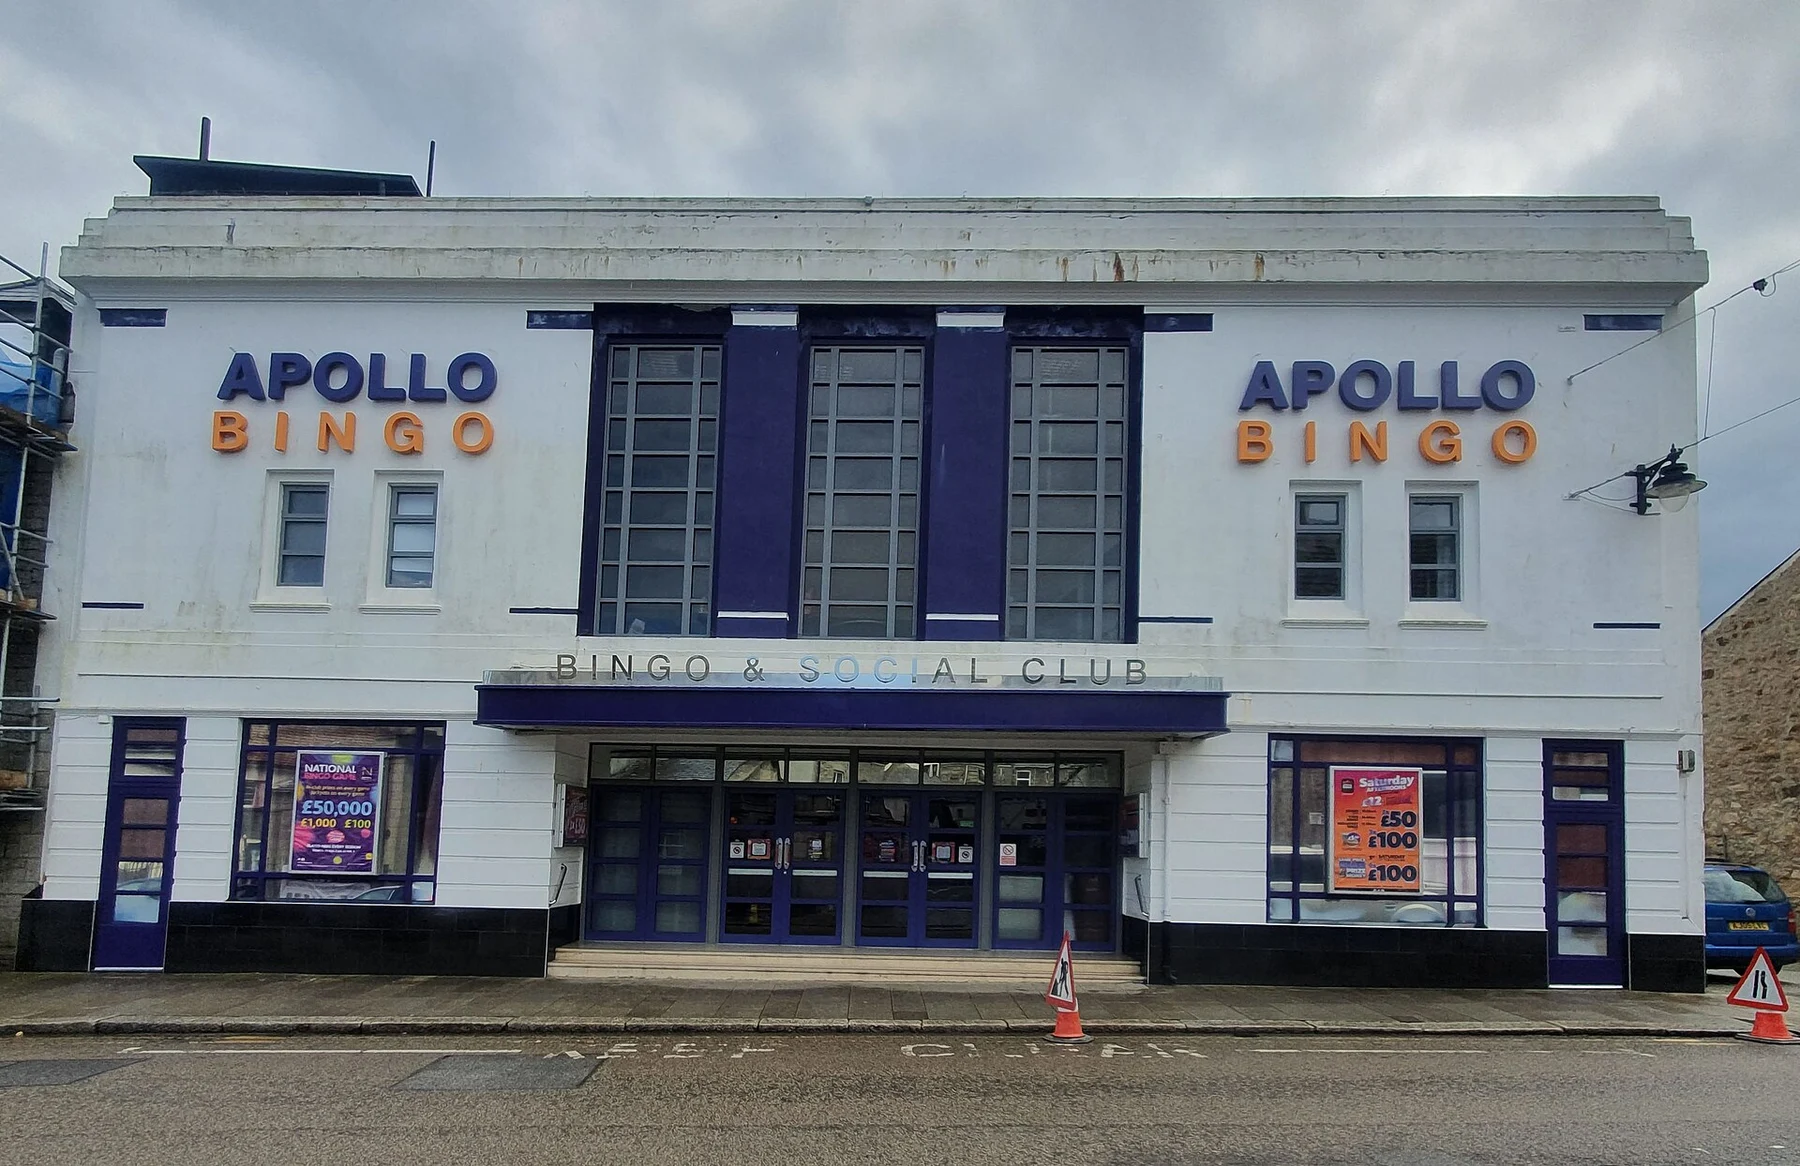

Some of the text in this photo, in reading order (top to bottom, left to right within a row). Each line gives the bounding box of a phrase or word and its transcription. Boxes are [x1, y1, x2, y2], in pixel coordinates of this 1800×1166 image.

[216, 351, 499, 403] APOLLO
[1238, 359, 1537, 412] APOLLO
[211, 410, 495, 454] BINGO
[1237, 420, 1538, 463] BINGO
[556, 654, 1148, 686] BINGO & SOCIAL CLUB
[304, 764, 357, 774] NATIONAL
[1359, 775, 1415, 788] Saturday
[301, 800, 373, 817] £50,000
[300, 817, 371, 829] £1,000 £100
[1381, 811, 1416, 828] £50
[1368, 831, 1417, 849] £100
[1368, 865, 1417, 882] £100
